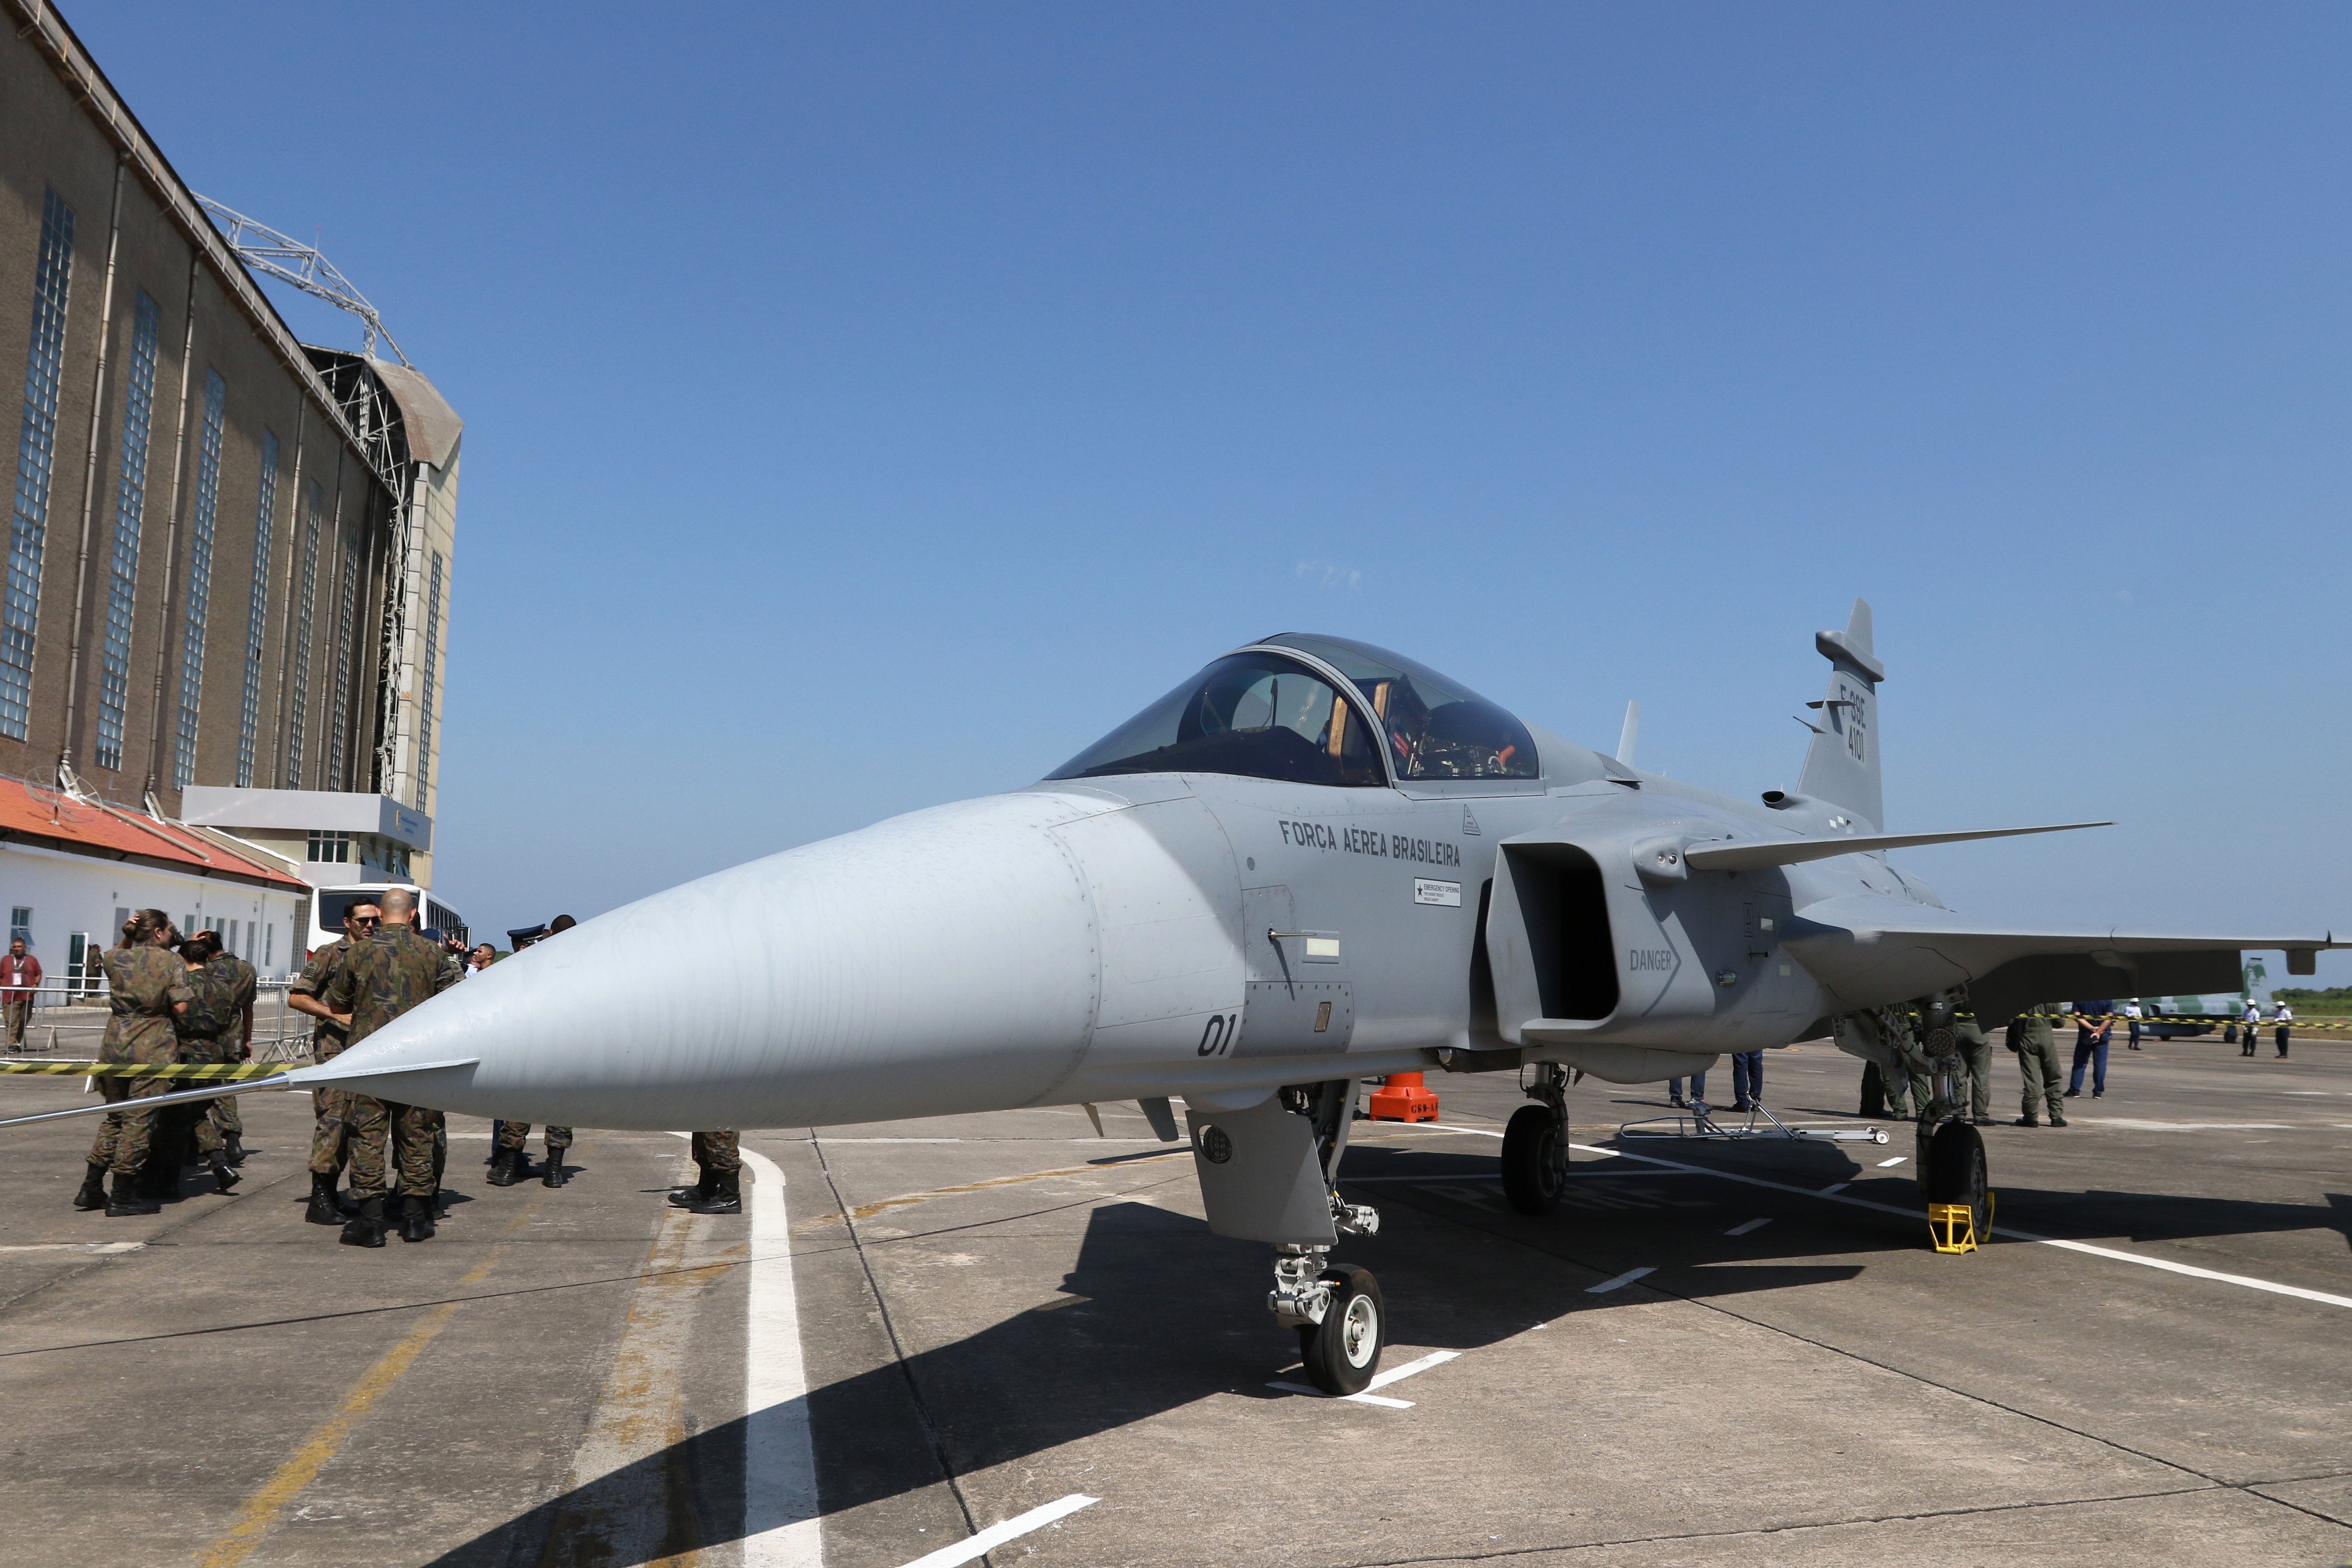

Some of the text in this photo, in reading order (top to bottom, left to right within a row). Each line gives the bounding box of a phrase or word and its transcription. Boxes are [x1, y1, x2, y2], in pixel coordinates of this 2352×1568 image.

[1849, 725, 1864, 763] 4101
[1278, 820, 1461, 867] FORÇA AÉREA BRASILEIRA
[1424, 884, 1445, 892] EMERGENCY
[1630, 949, 1671, 971] DANGER
[1197, 1014, 1237, 1057] 01
